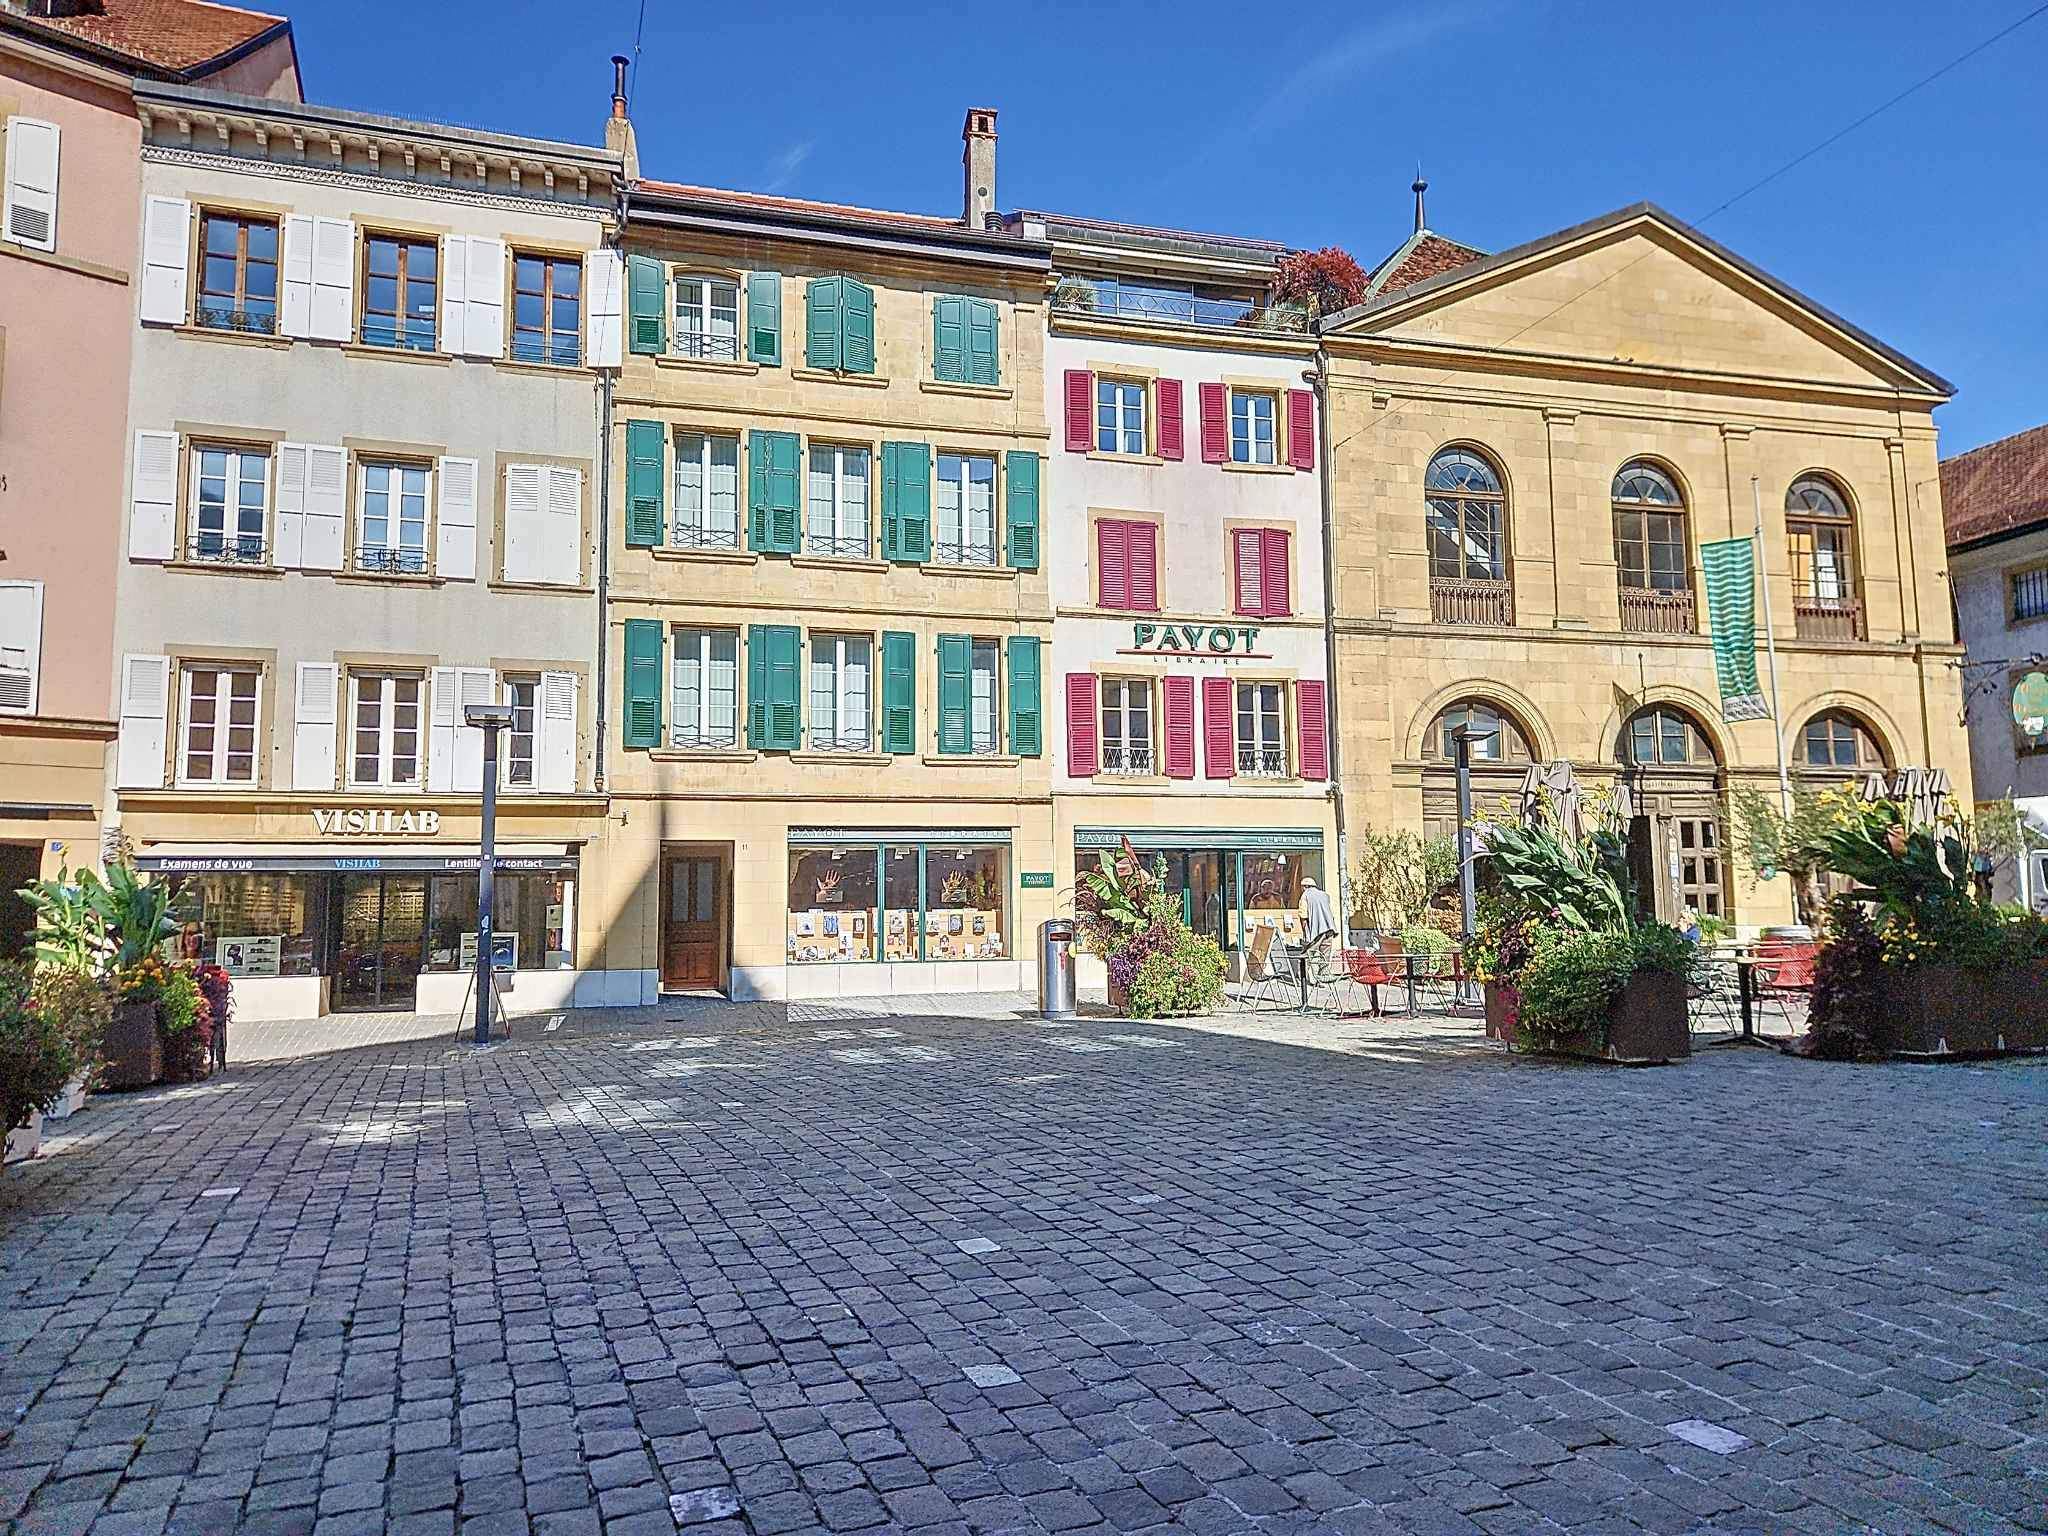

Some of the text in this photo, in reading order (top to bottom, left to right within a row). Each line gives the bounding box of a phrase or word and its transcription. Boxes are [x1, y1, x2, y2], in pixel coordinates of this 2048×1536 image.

[1134, 623, 1260, 653] PAYOT
[1154, 656, 1240, 665] LIBRAIRE
[312, 808, 440, 833] VISILAB
[160, 859, 253, 869] Examens de vue
[335, 859, 380, 868] VISILAB
[445, 858, 482, 868] Lentille
[505, 859, 544, 868] contact
